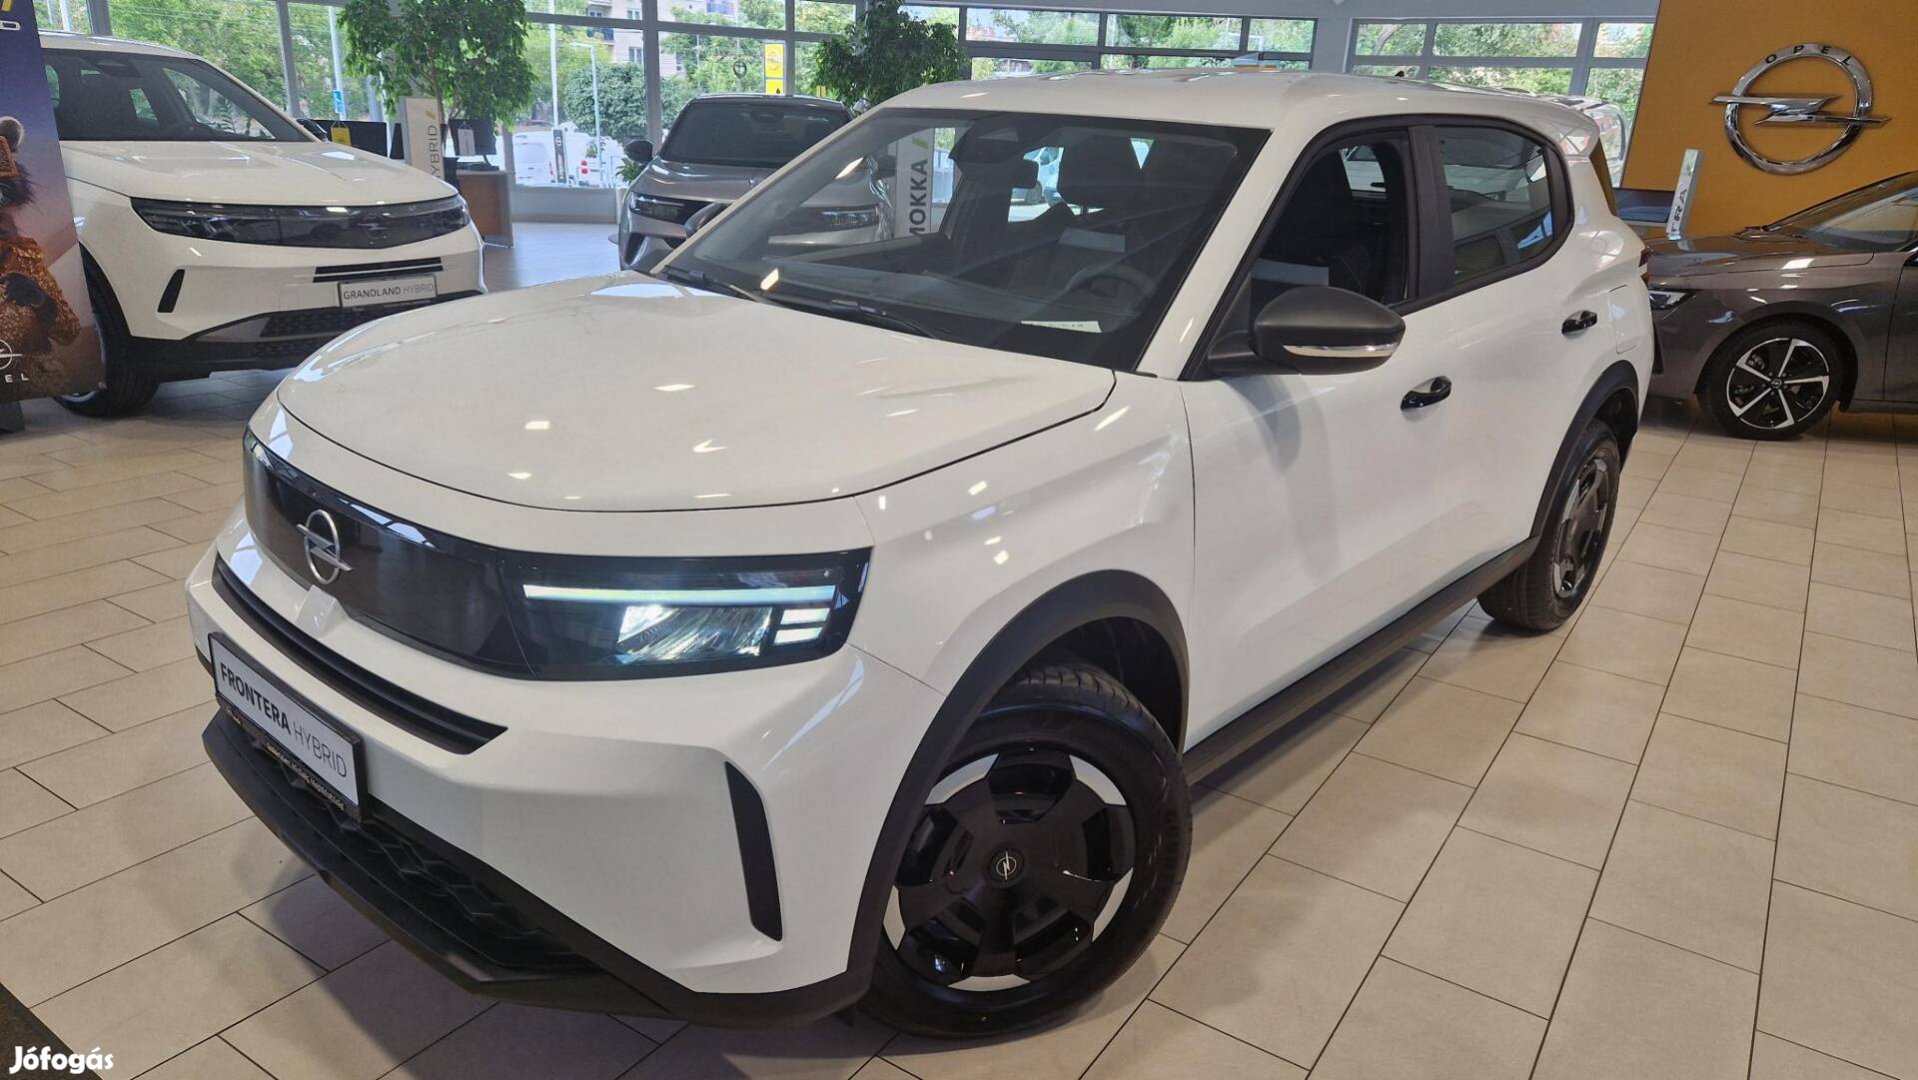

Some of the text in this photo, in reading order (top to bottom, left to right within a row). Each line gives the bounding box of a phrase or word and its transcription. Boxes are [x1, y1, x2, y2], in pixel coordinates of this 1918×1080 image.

[1765, 44, 1852, 66] OPEL
[427, 124, 441, 178] YBRID
[343, 283, 434, 300] GRANDLAND HYBRID
[220, 662, 291, 735] FRONTERA
[293, 720, 347, 778] HYBRID
